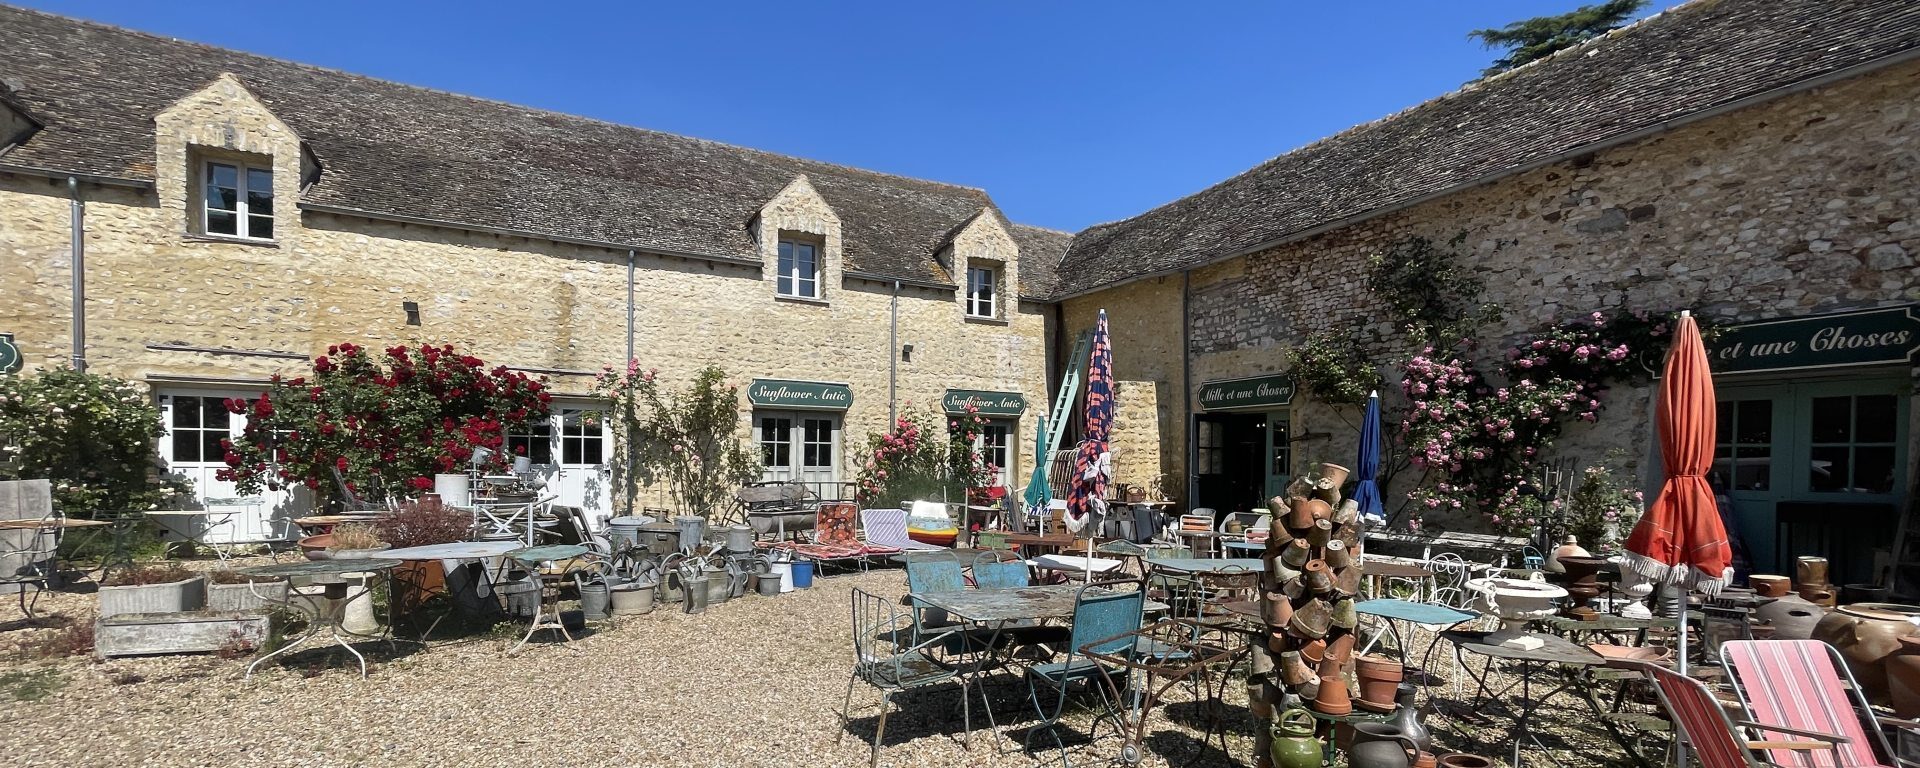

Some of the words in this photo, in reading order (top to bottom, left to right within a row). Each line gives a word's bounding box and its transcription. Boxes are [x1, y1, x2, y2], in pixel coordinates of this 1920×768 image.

[1719, 342, 1743, 359] et
[1750, 340, 1798, 357] une
[1810, 326, 1911, 352] Choses
[754, 385, 812, 402] Sunflower
[814, 388, 846, 401] Antic
[1201, 388, 1225, 402] Mille
[1226, 390, 1235, 400] et
[1236, 389, 1254, 399] une
[1256, 382, 1290, 398] Choses
[995, 397, 1021, 408] Antic
